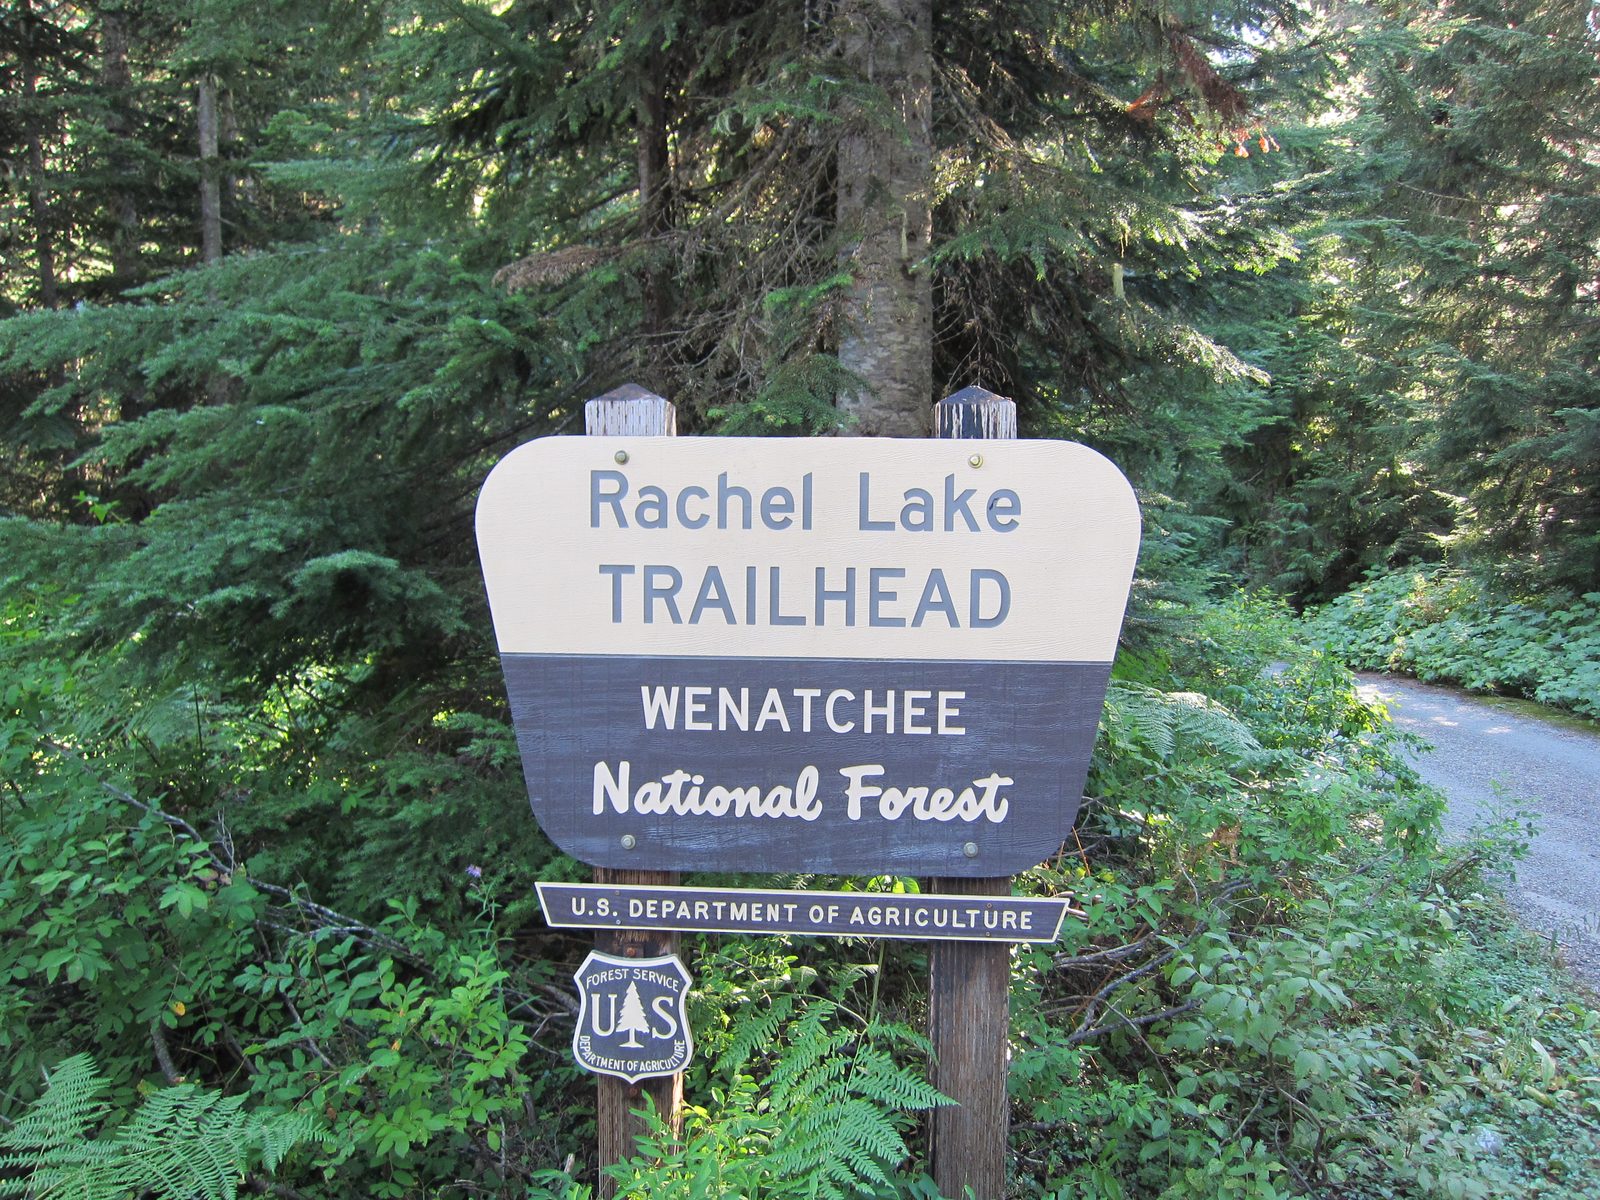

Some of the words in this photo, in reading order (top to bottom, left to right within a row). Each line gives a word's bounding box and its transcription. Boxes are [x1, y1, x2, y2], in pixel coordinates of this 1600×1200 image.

[589, 469, 813, 532] Rachel
[858, 472, 1022, 533] Lake
[598, 564, 1012, 630] TRAILHEAD
[640, 685, 967, 736] WENATCHEE
[592, 760, 824, 822] National
[838, 763, 1015, 824] Forest
[571, 897, 618, 918] U.S.
[628, 898, 798, 924] DEPARTMENT
[808, 903, 839, 925] OF
[849, 904, 1034, 931] AGRICULTURE
[586, 968, 629, 990] FOREST
[632, 968, 679, 993] SERVICE
[579, 1035, 625, 1071] DEPARTMENT
[626, 1060, 639, 1072] OF
[639, 1039, 685, 1072] AGRICULTURE
